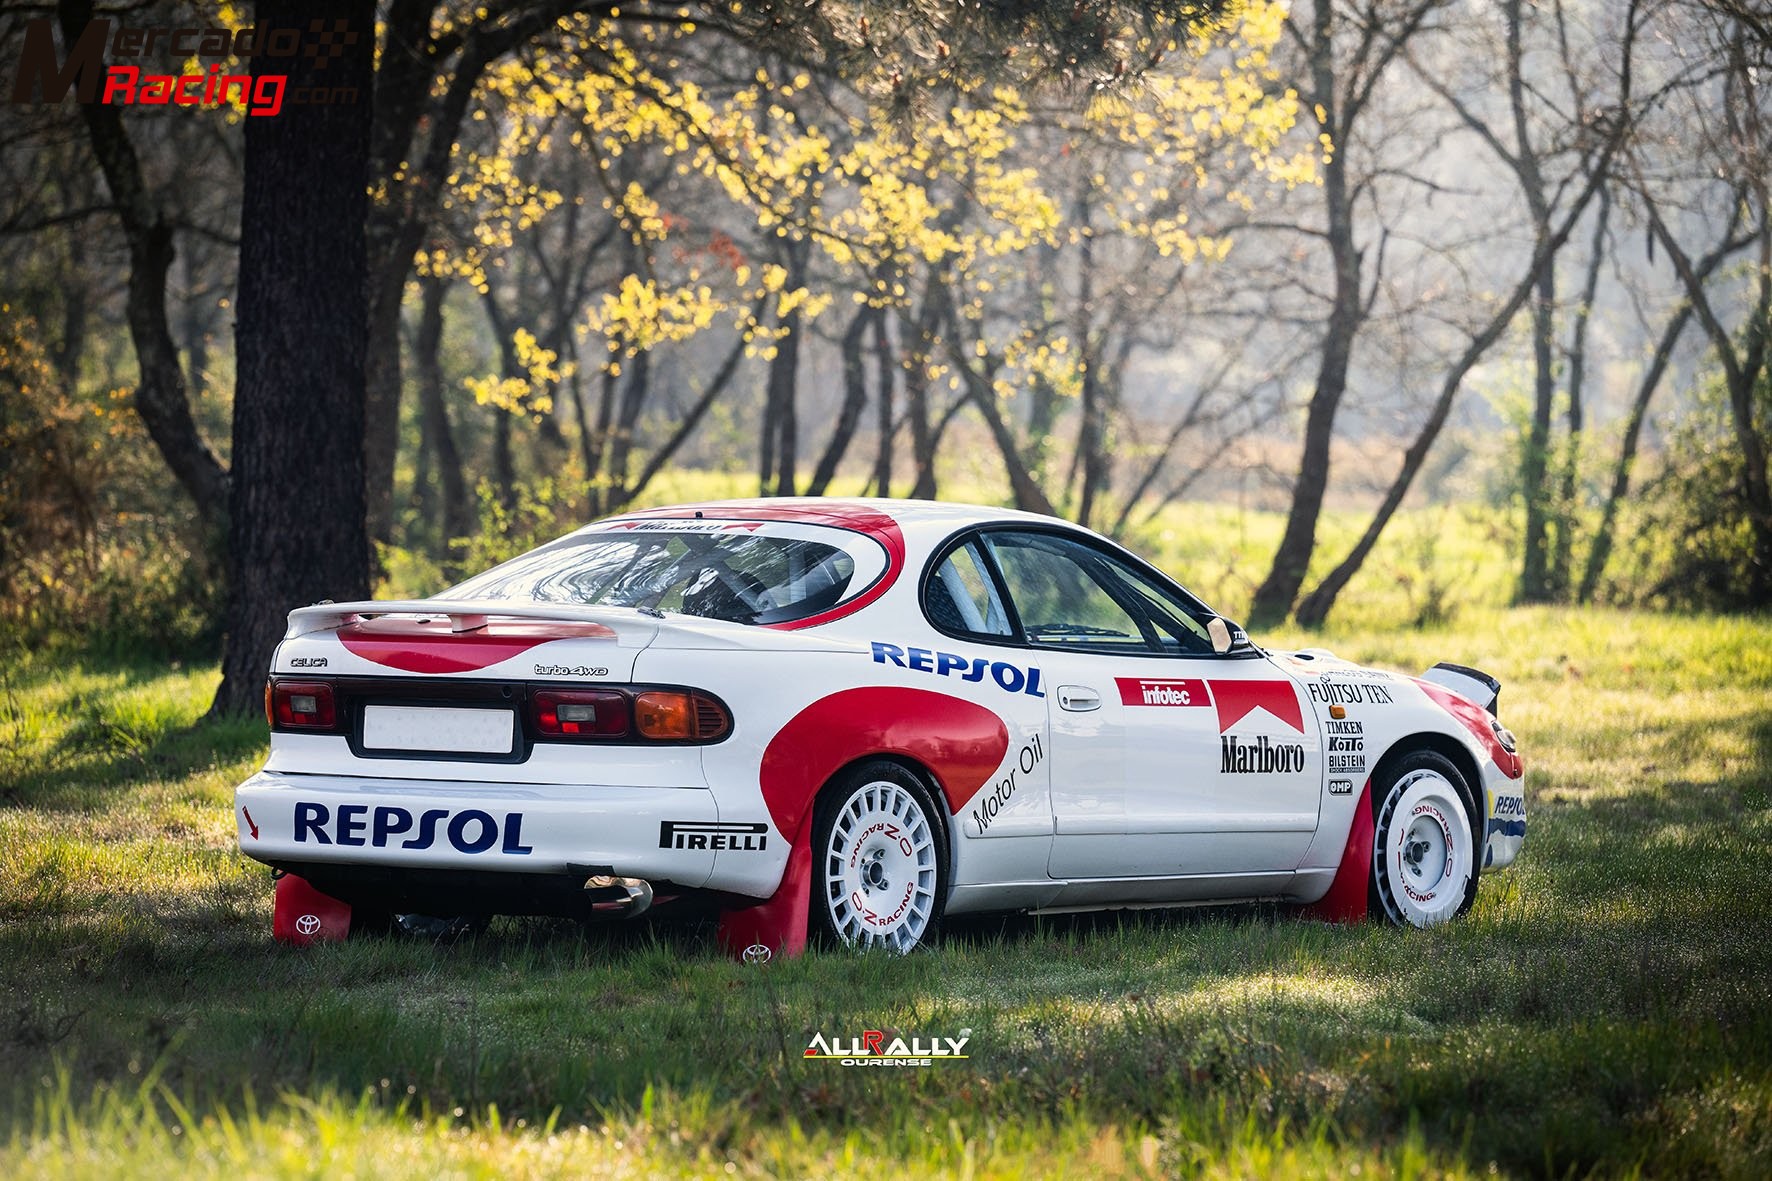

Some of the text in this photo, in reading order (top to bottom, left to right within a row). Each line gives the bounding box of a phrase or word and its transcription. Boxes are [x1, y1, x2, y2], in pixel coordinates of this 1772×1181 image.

[290, 657, 328, 668] CELICA
[871, 641, 1045, 698] REPSOL
[1141, 684, 1190, 705] infotec
[1307, 682, 1394, 705] FUJITSU TEN
[1325, 721, 1363, 734] TIMKEN
[1220, 735, 1305, 773] Marlboro
[1329, 755, 1365, 767] BILSTEIN
[973, 733, 1043, 834] Motor Oil
[1330, 781, 1351, 793] OMP
[294, 801, 533, 855] REPSOL
[659, 820, 768, 851] PIRELLI
[850, 823, 885, 869] RACING
[878, 881, 914, 927] RACING
